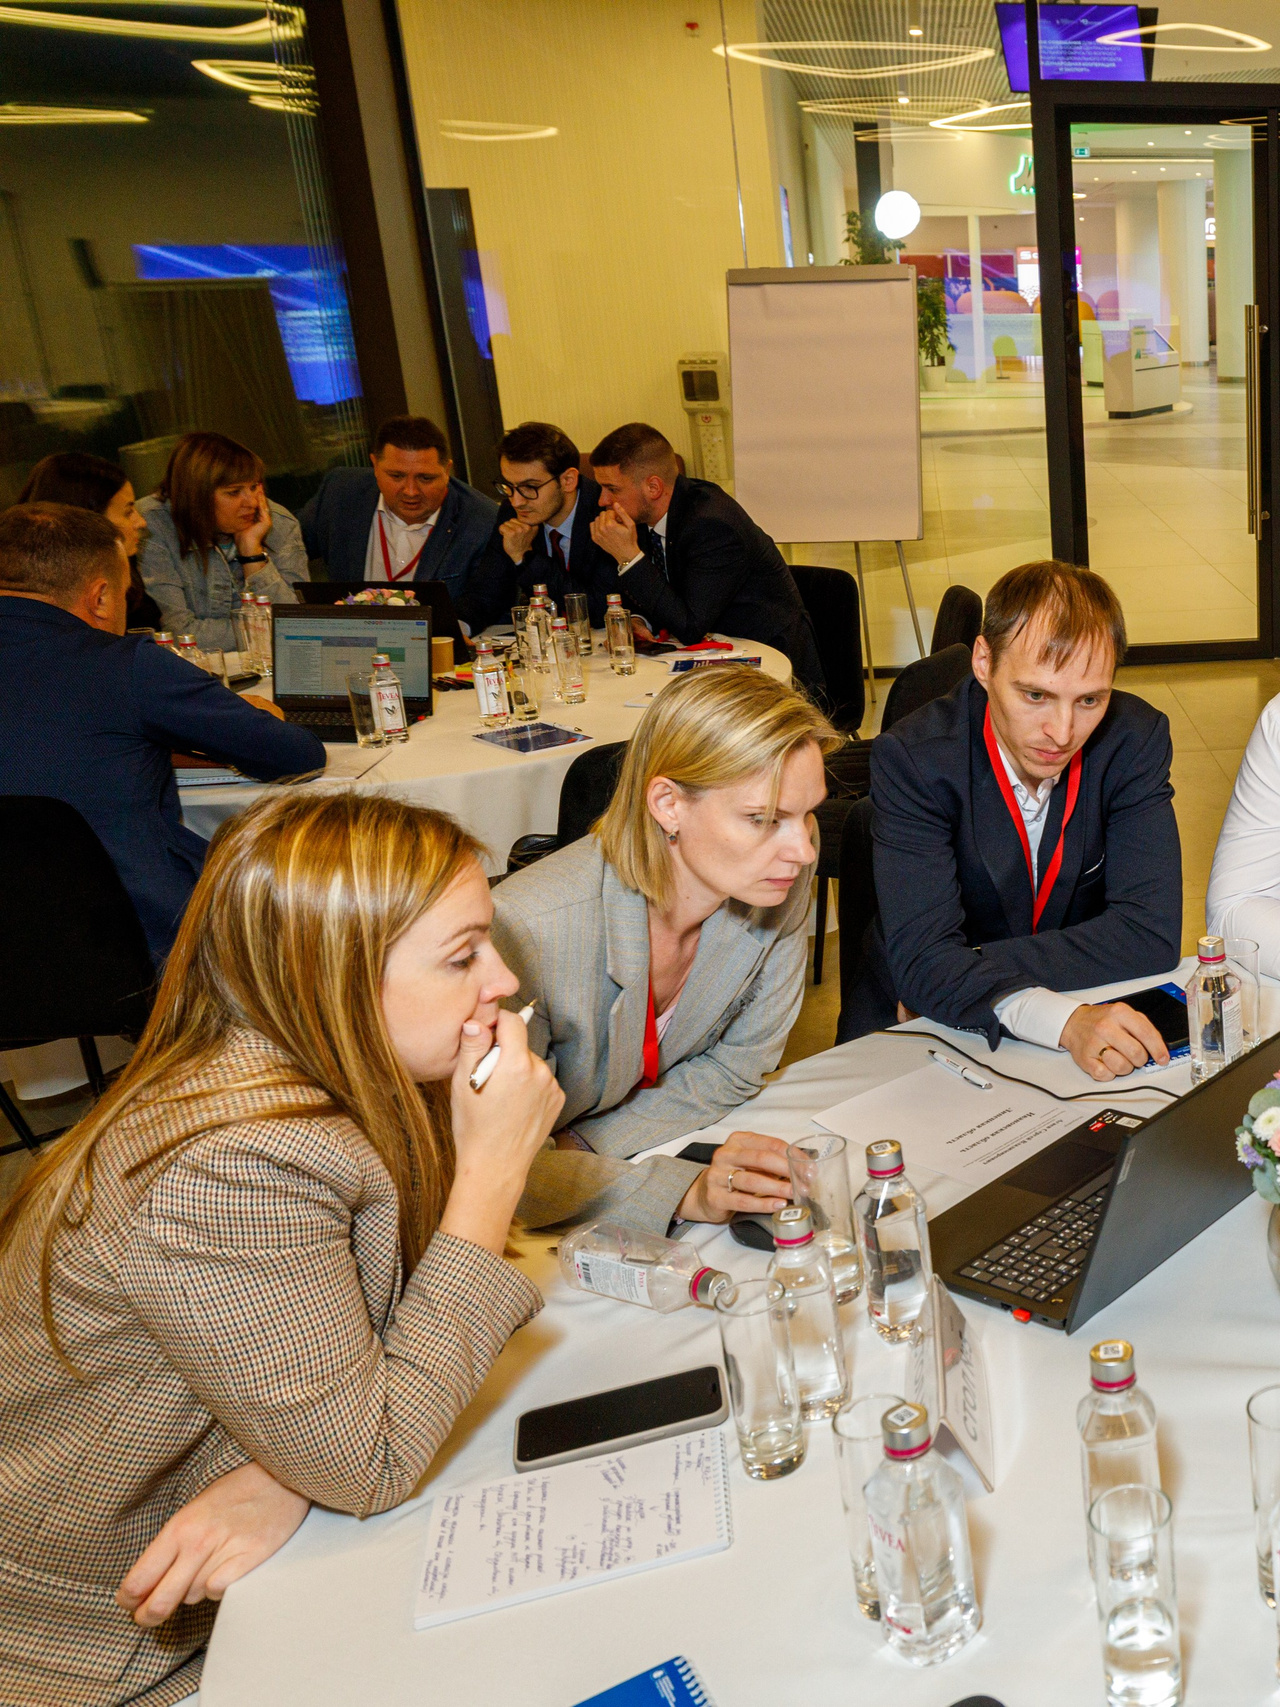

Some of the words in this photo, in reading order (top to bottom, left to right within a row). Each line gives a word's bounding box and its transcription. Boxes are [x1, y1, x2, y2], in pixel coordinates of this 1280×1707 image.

[990, 1111, 1035, 1137] Ивановская
[946, 1127, 977, 1145] область
[959, 1134, 991, 1153] область
